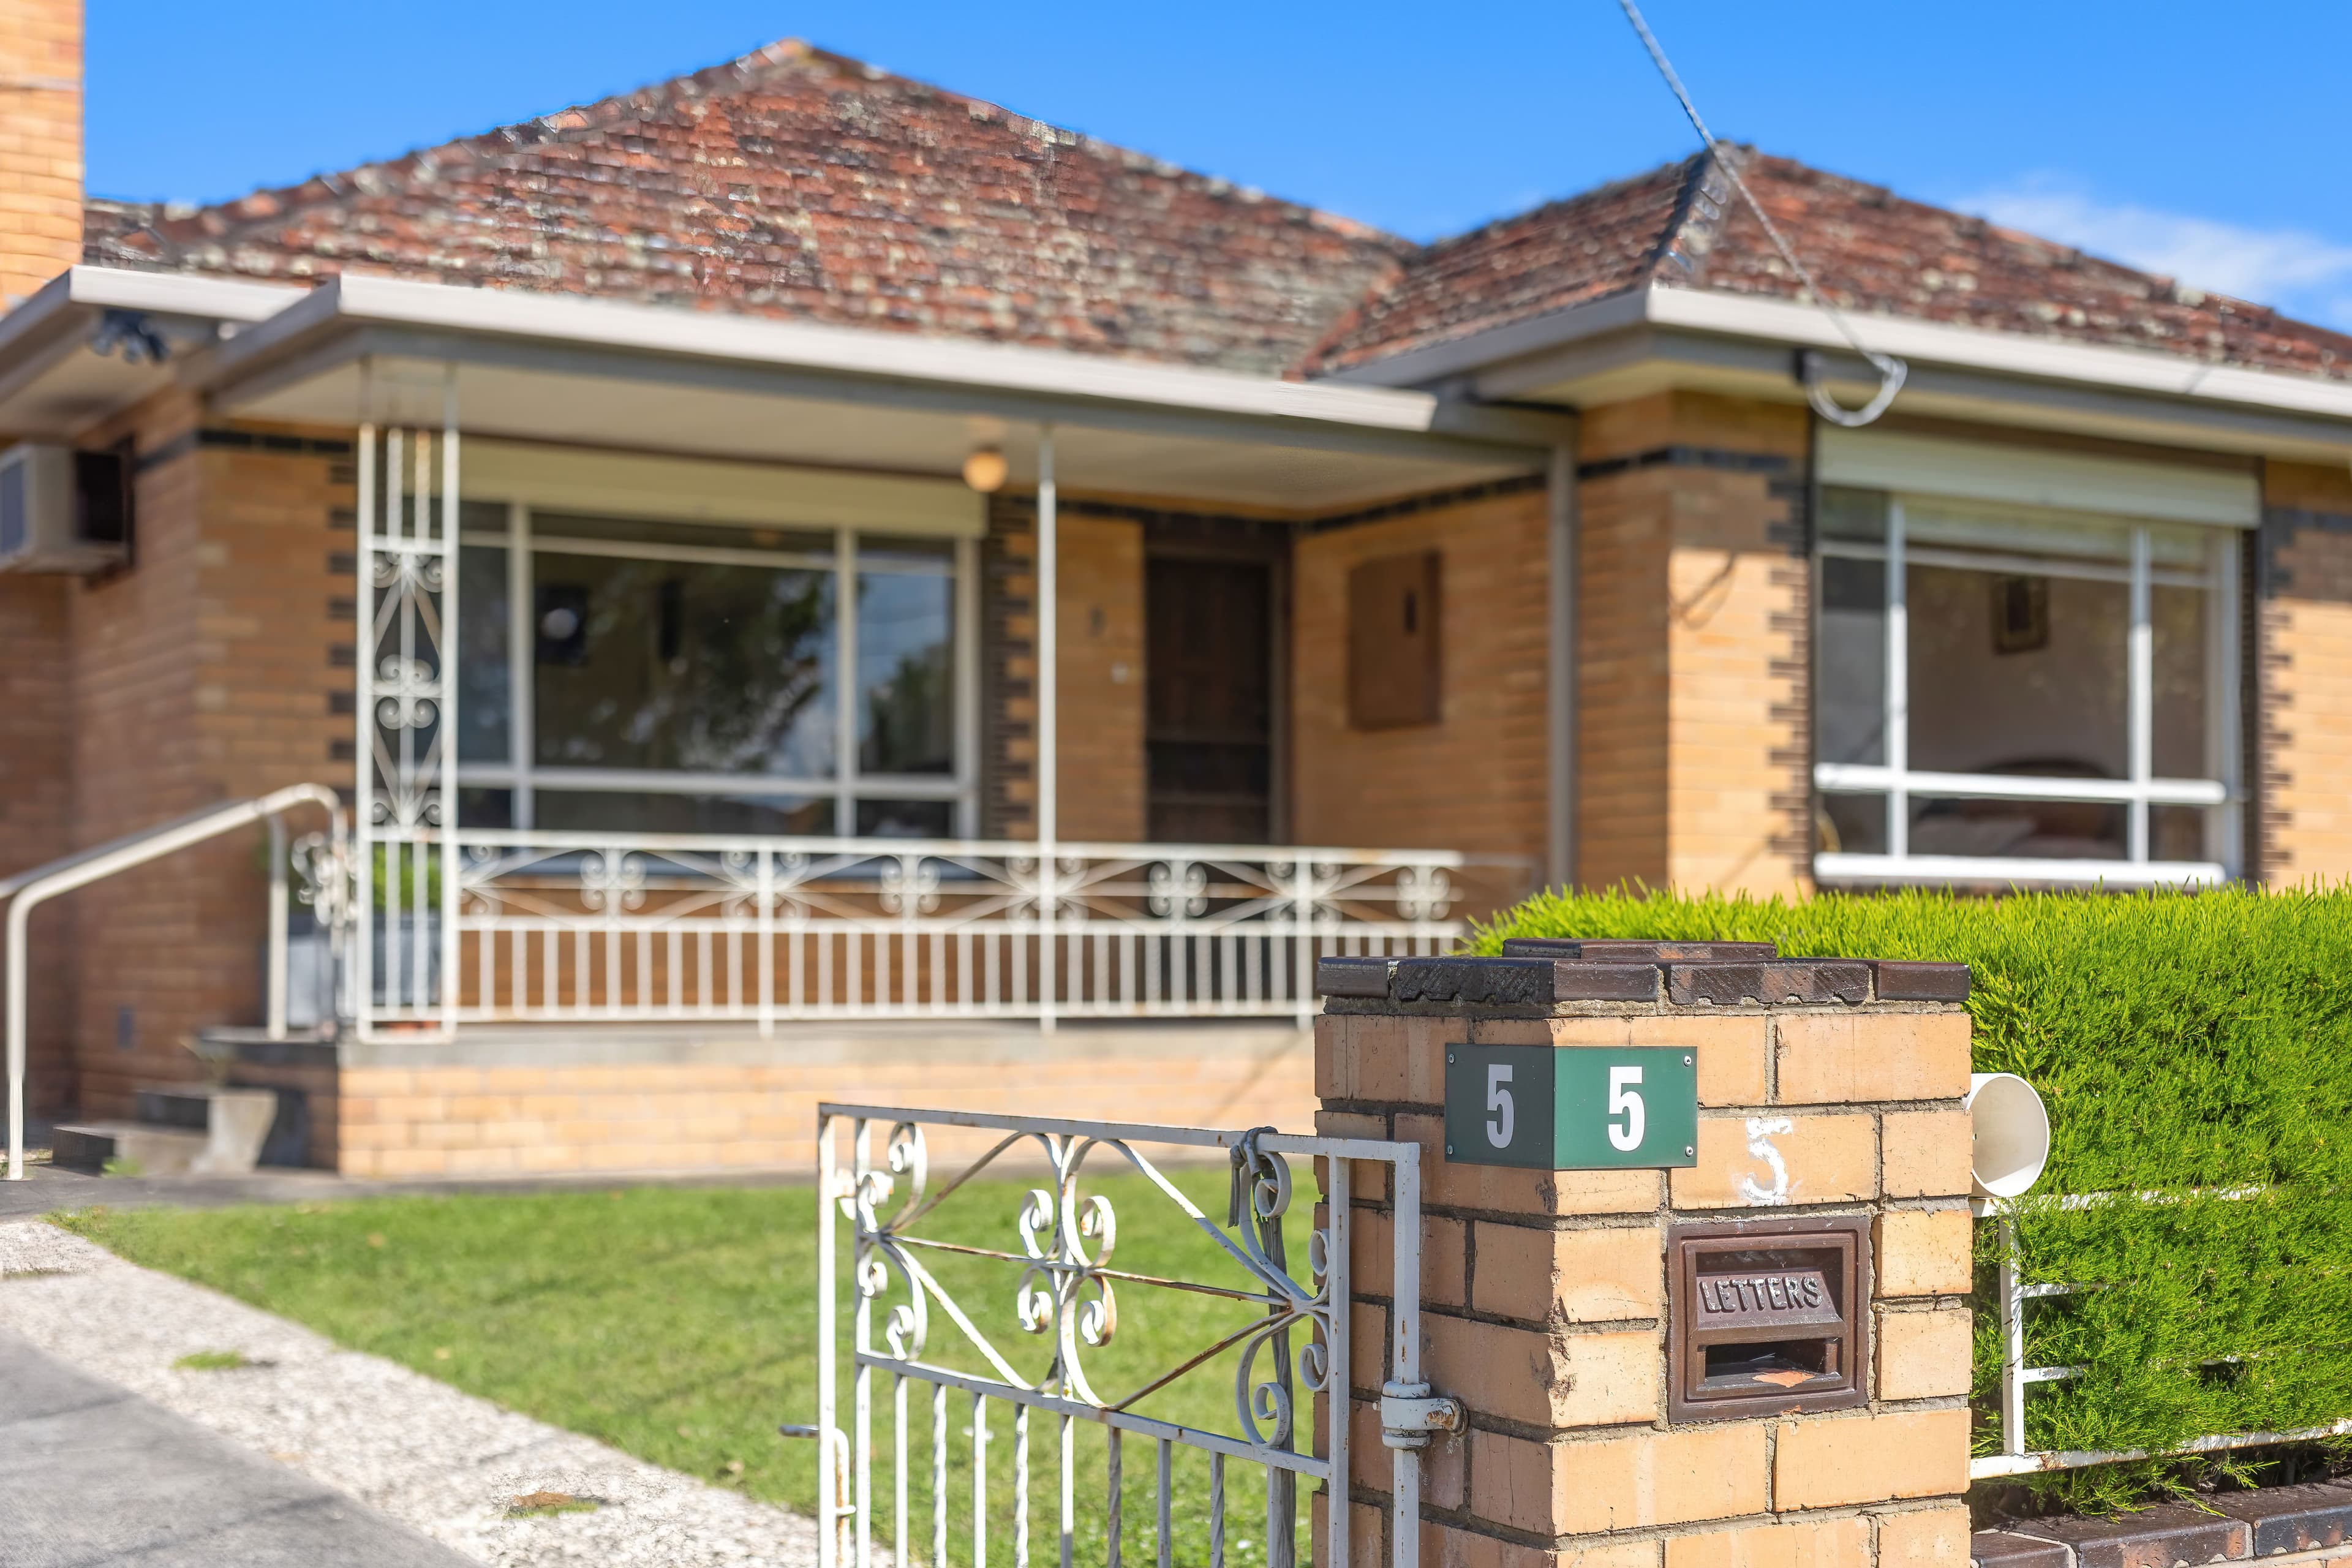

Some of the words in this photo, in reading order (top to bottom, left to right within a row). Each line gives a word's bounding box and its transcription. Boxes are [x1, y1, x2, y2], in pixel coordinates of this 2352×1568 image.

[1487, 1063, 1515, 1148] 5
[1608, 1066, 1646, 1152] 5
[1743, 1117, 1793, 1207] 5
[1699, 1276, 1824, 1313] LETTERS
